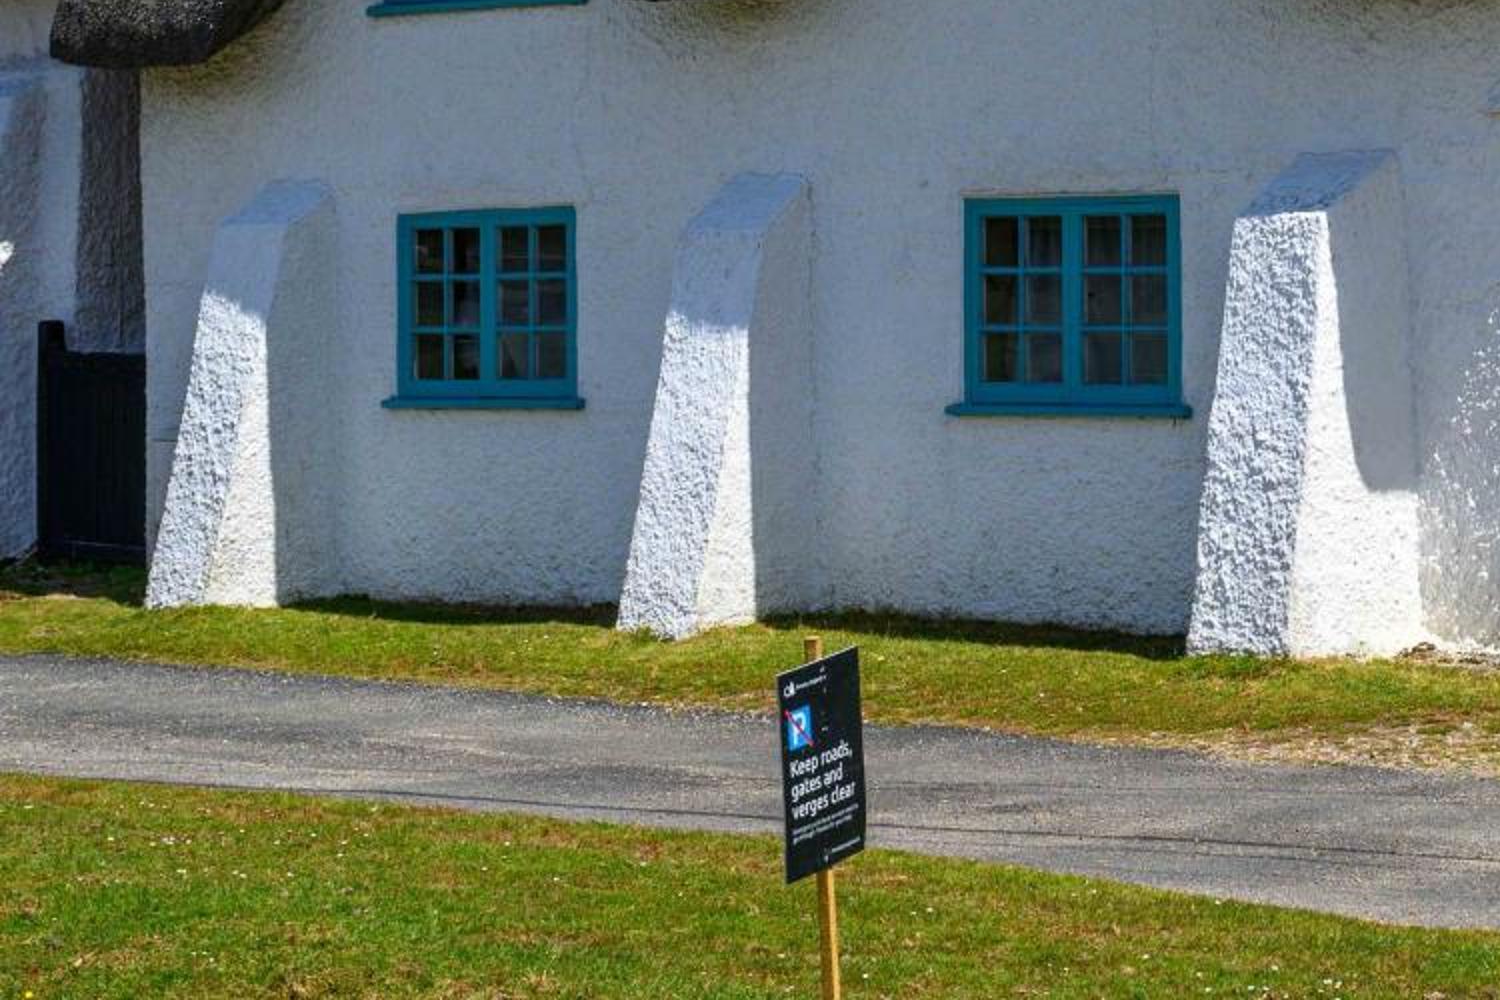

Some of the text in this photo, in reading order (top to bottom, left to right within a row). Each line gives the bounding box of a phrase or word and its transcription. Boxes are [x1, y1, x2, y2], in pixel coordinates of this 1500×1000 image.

[789, 756, 819, 778] Keep
[791, 761, 844, 803] gates and
[791, 794, 829, 820] verges
[831, 782, 856, 804] clear
